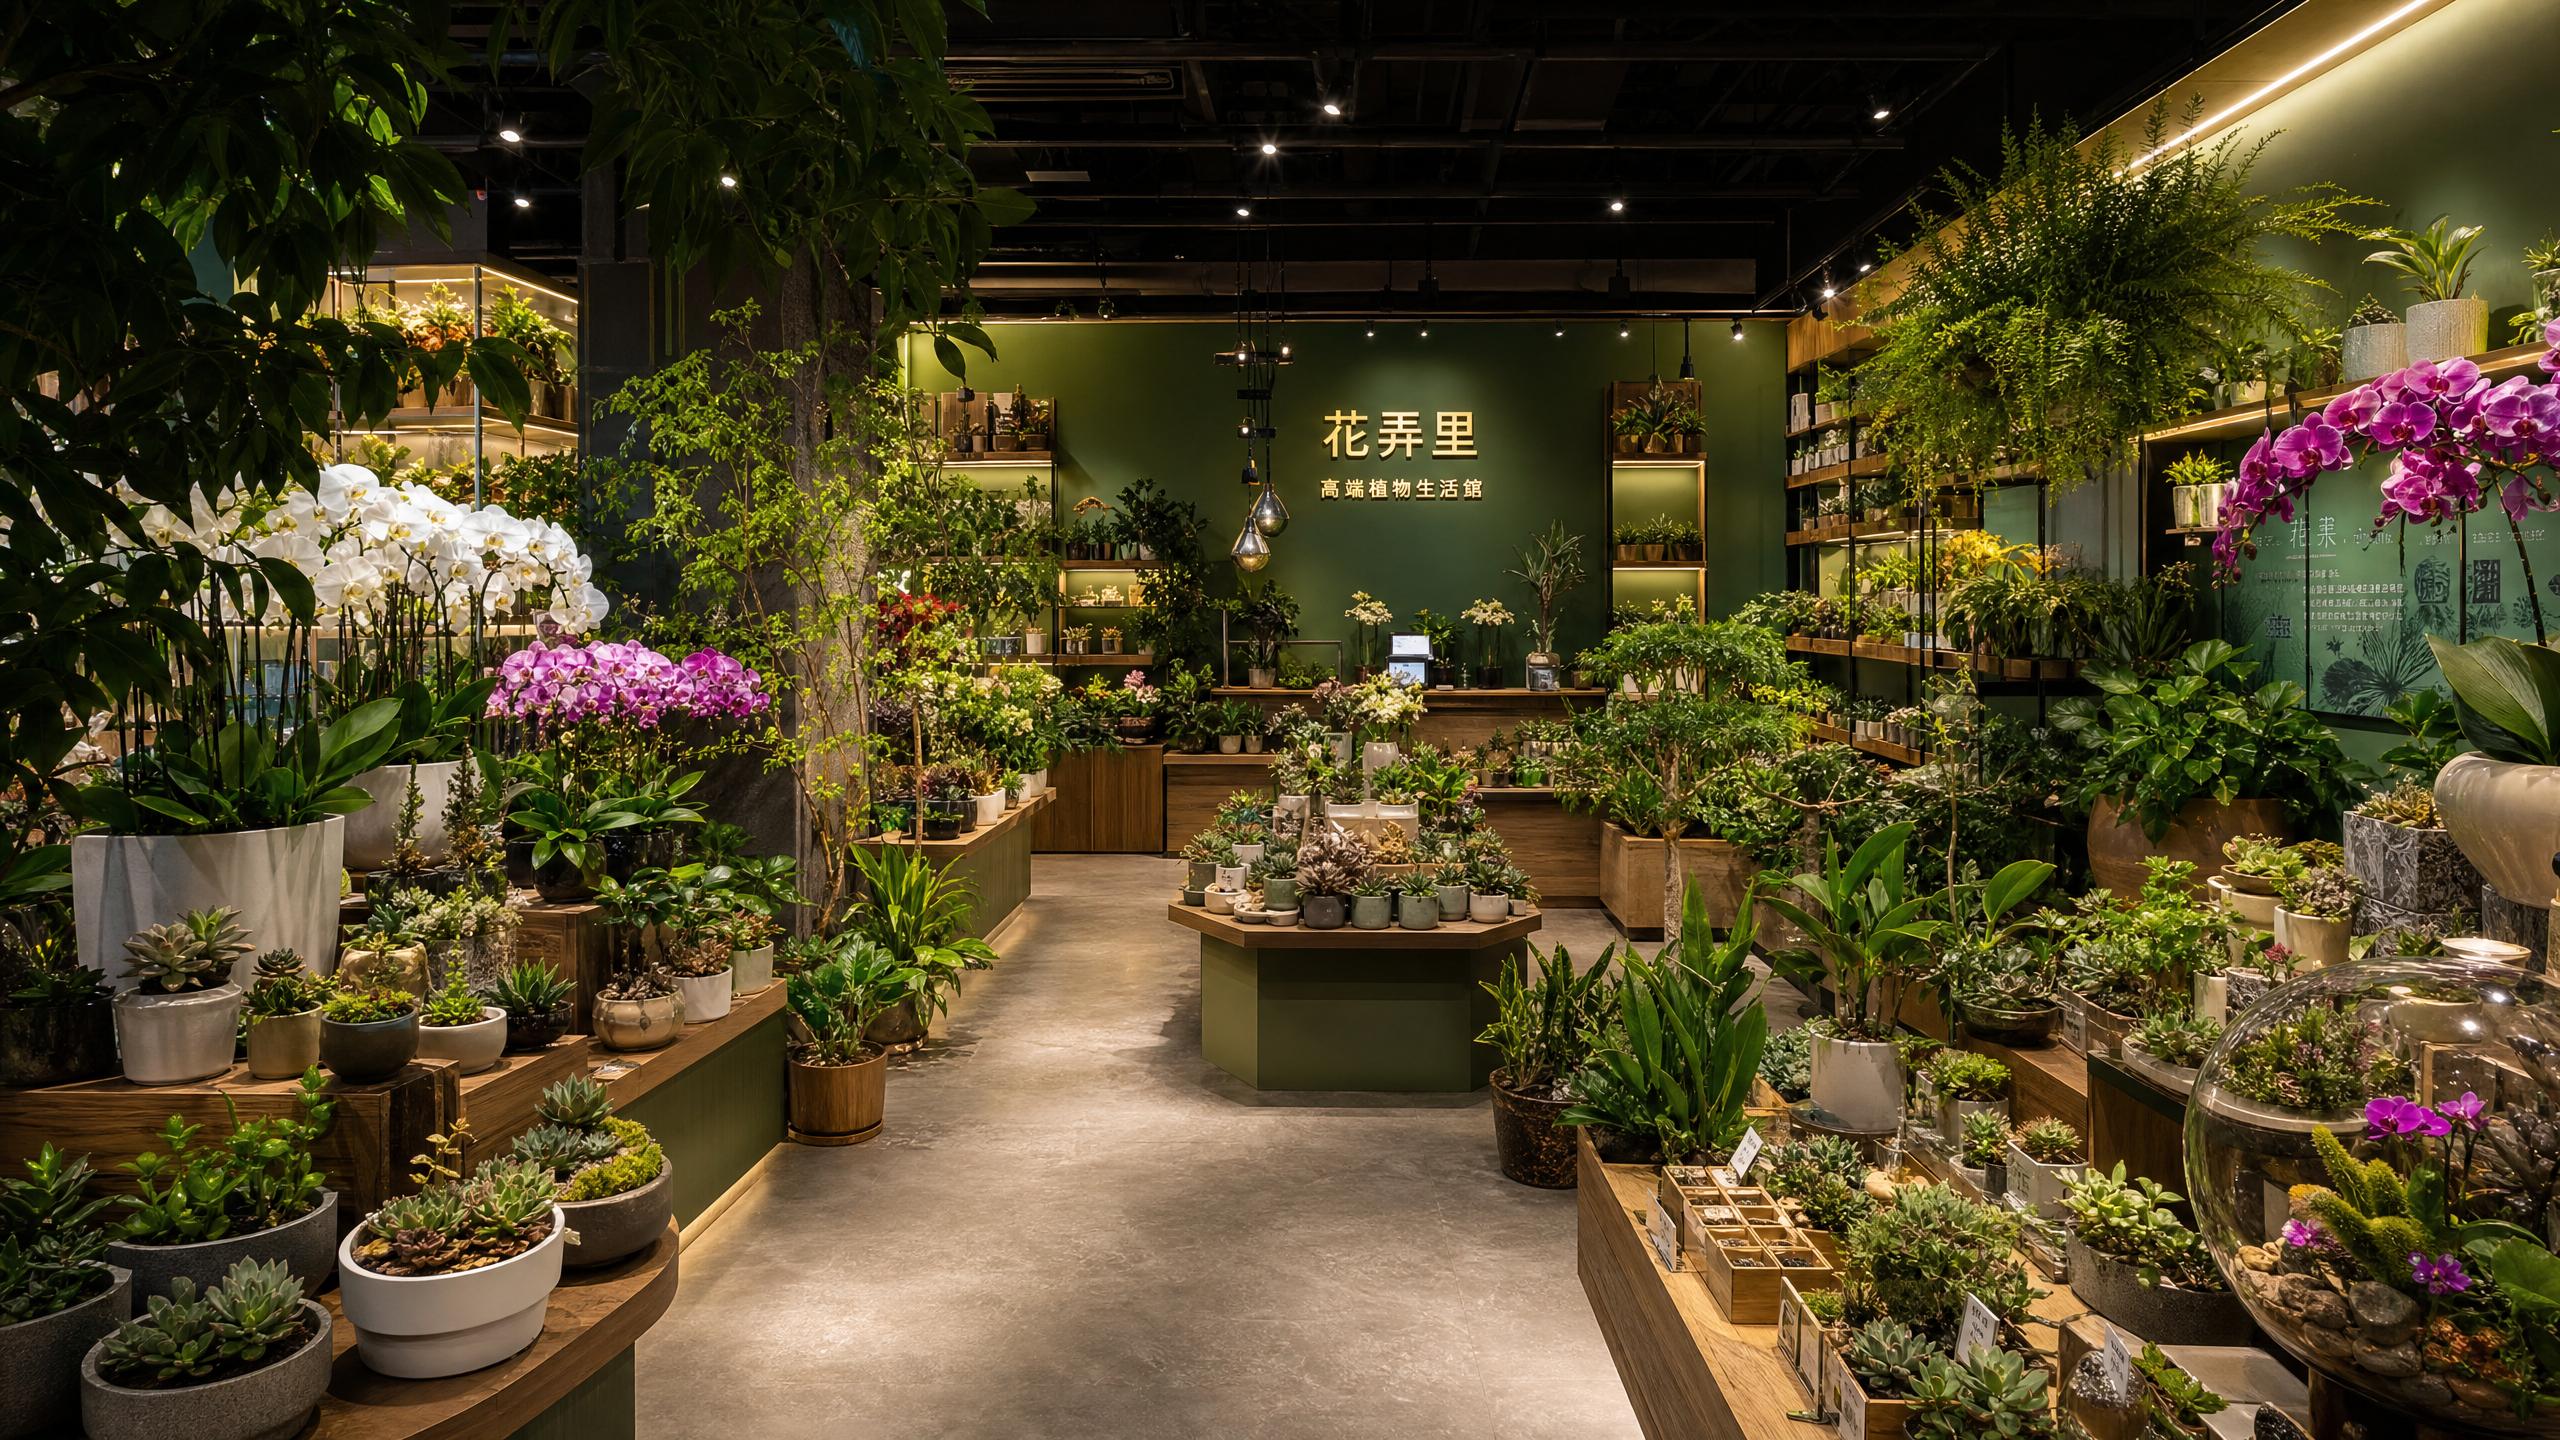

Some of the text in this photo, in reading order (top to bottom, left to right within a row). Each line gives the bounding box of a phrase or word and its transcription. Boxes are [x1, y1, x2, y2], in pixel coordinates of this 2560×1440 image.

[1323, 410, 1478, 459] 花弄里
[1320, 478, 1483, 499] 高端植物生活館
